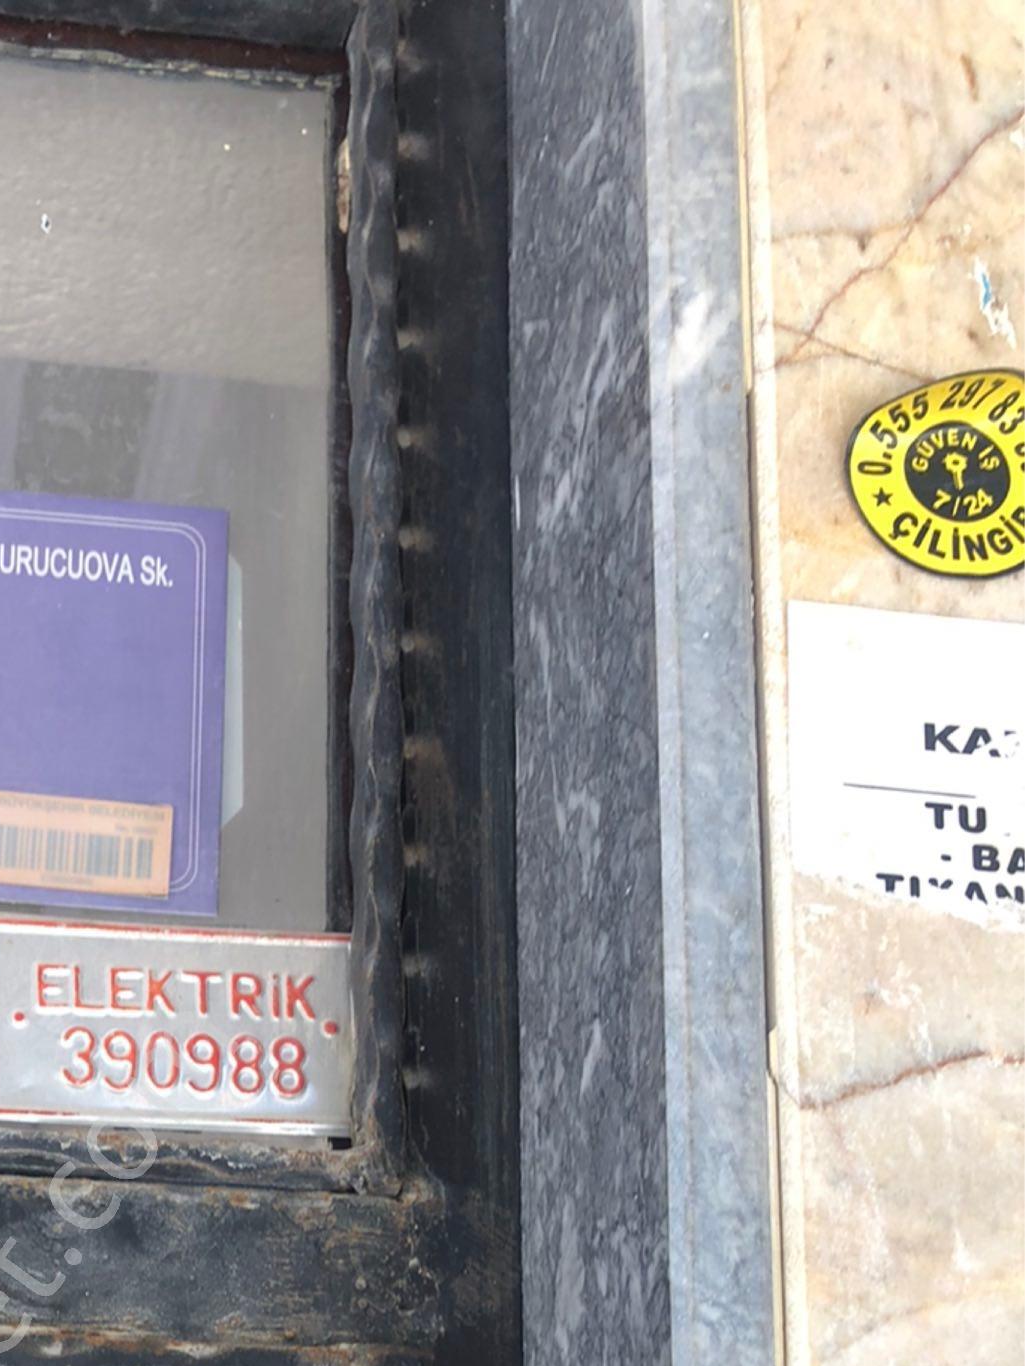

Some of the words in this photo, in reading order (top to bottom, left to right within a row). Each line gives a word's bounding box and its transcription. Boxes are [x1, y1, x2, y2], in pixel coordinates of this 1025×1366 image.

[938, 378, 1007, 411] 297
[933, 488, 993, 517] 7/24
[140, 557, 174, 588] Sk.
[923, 722, 1019, 758] KA
[61, 1025, 310, 1099] 390988
